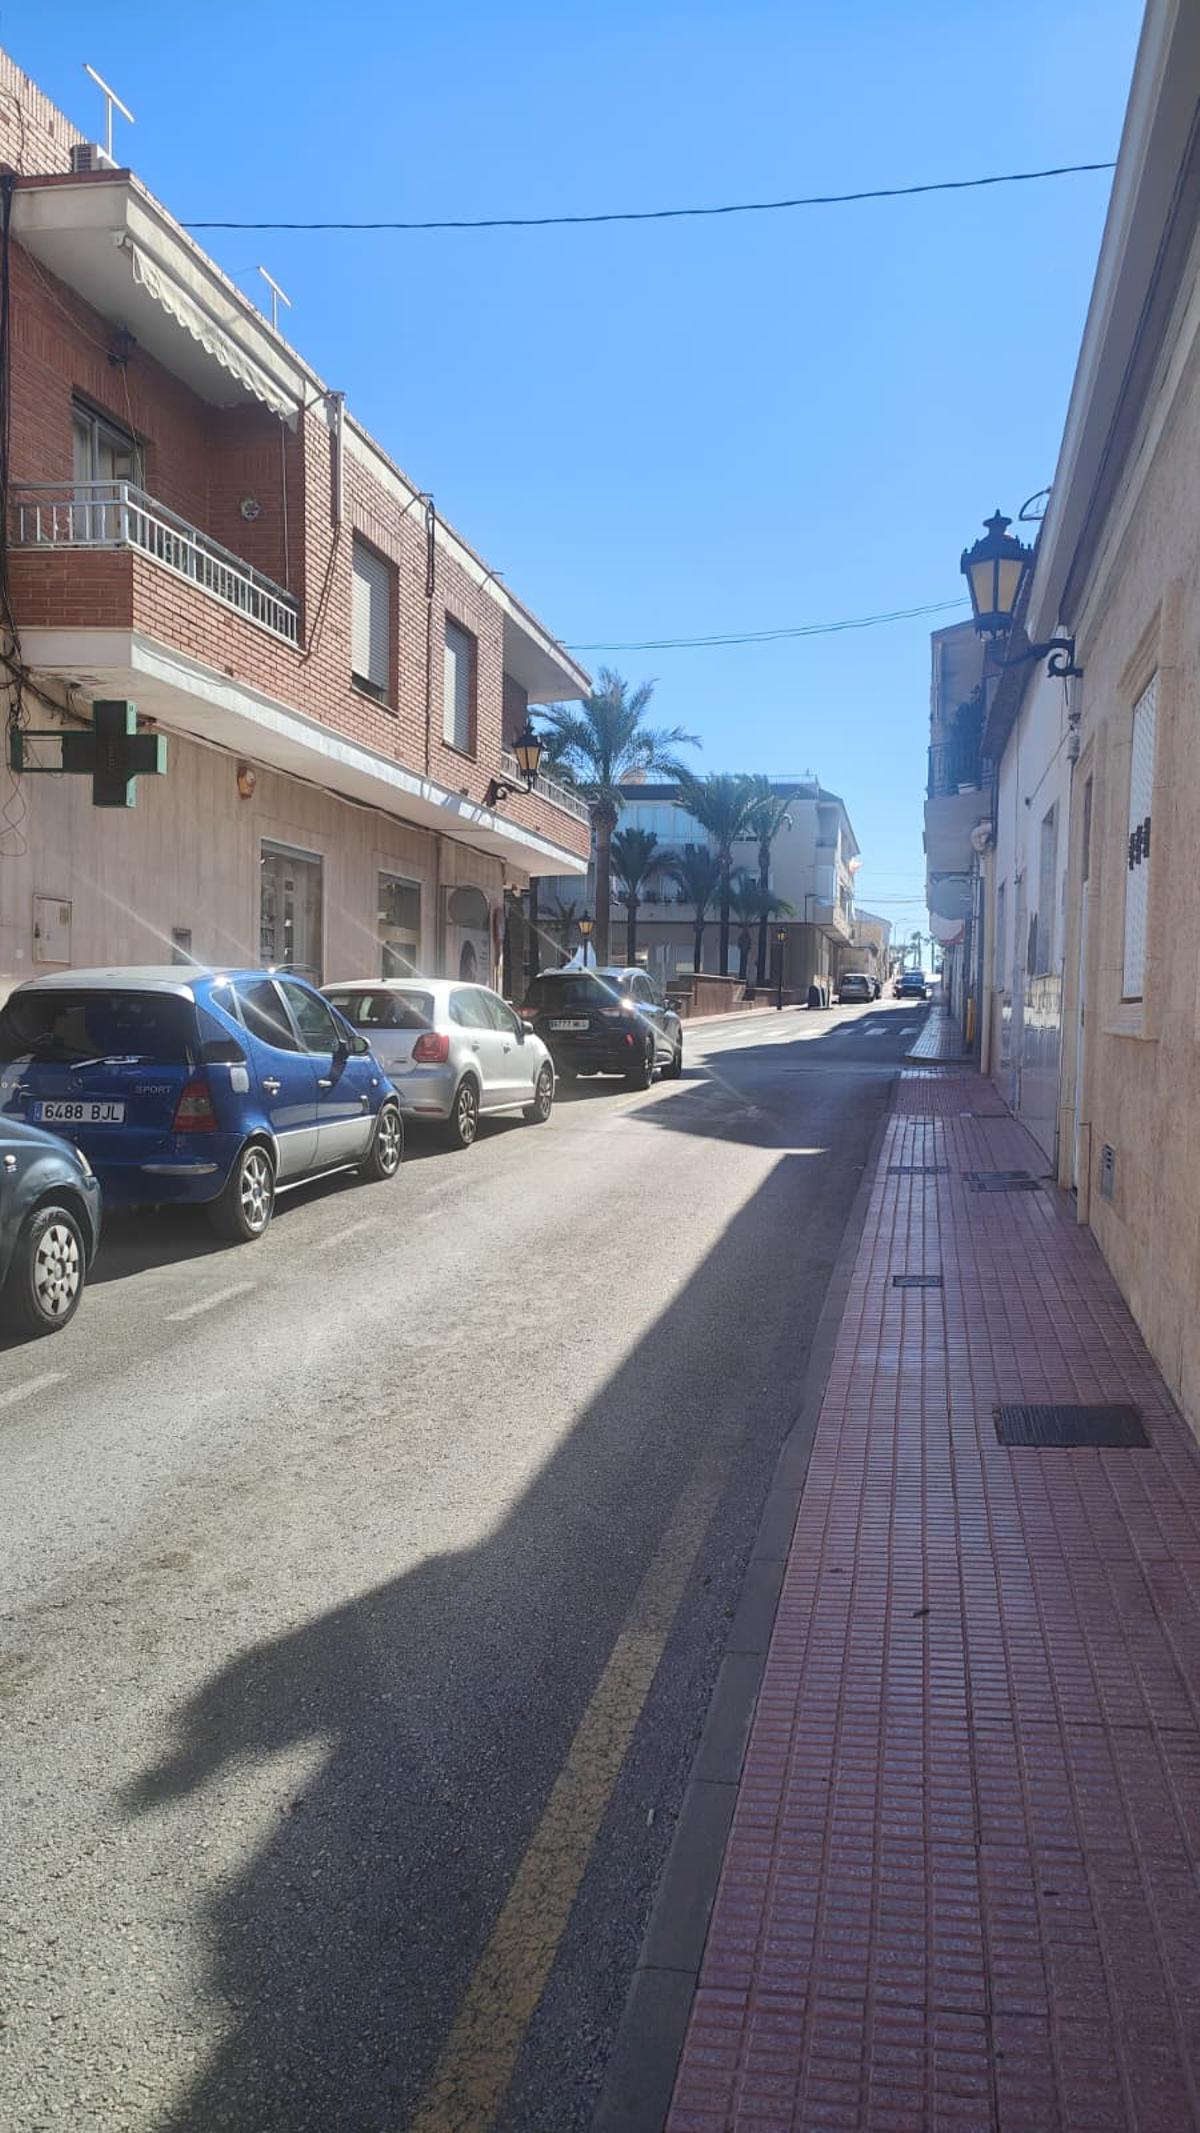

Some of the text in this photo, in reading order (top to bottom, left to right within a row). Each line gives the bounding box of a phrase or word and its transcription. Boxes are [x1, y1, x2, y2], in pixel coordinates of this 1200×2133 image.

[135, 1085, 172, 1094] SPORT
[44, 1104, 83, 1120] 6488
[91, 1104, 120, 1121] BJL
